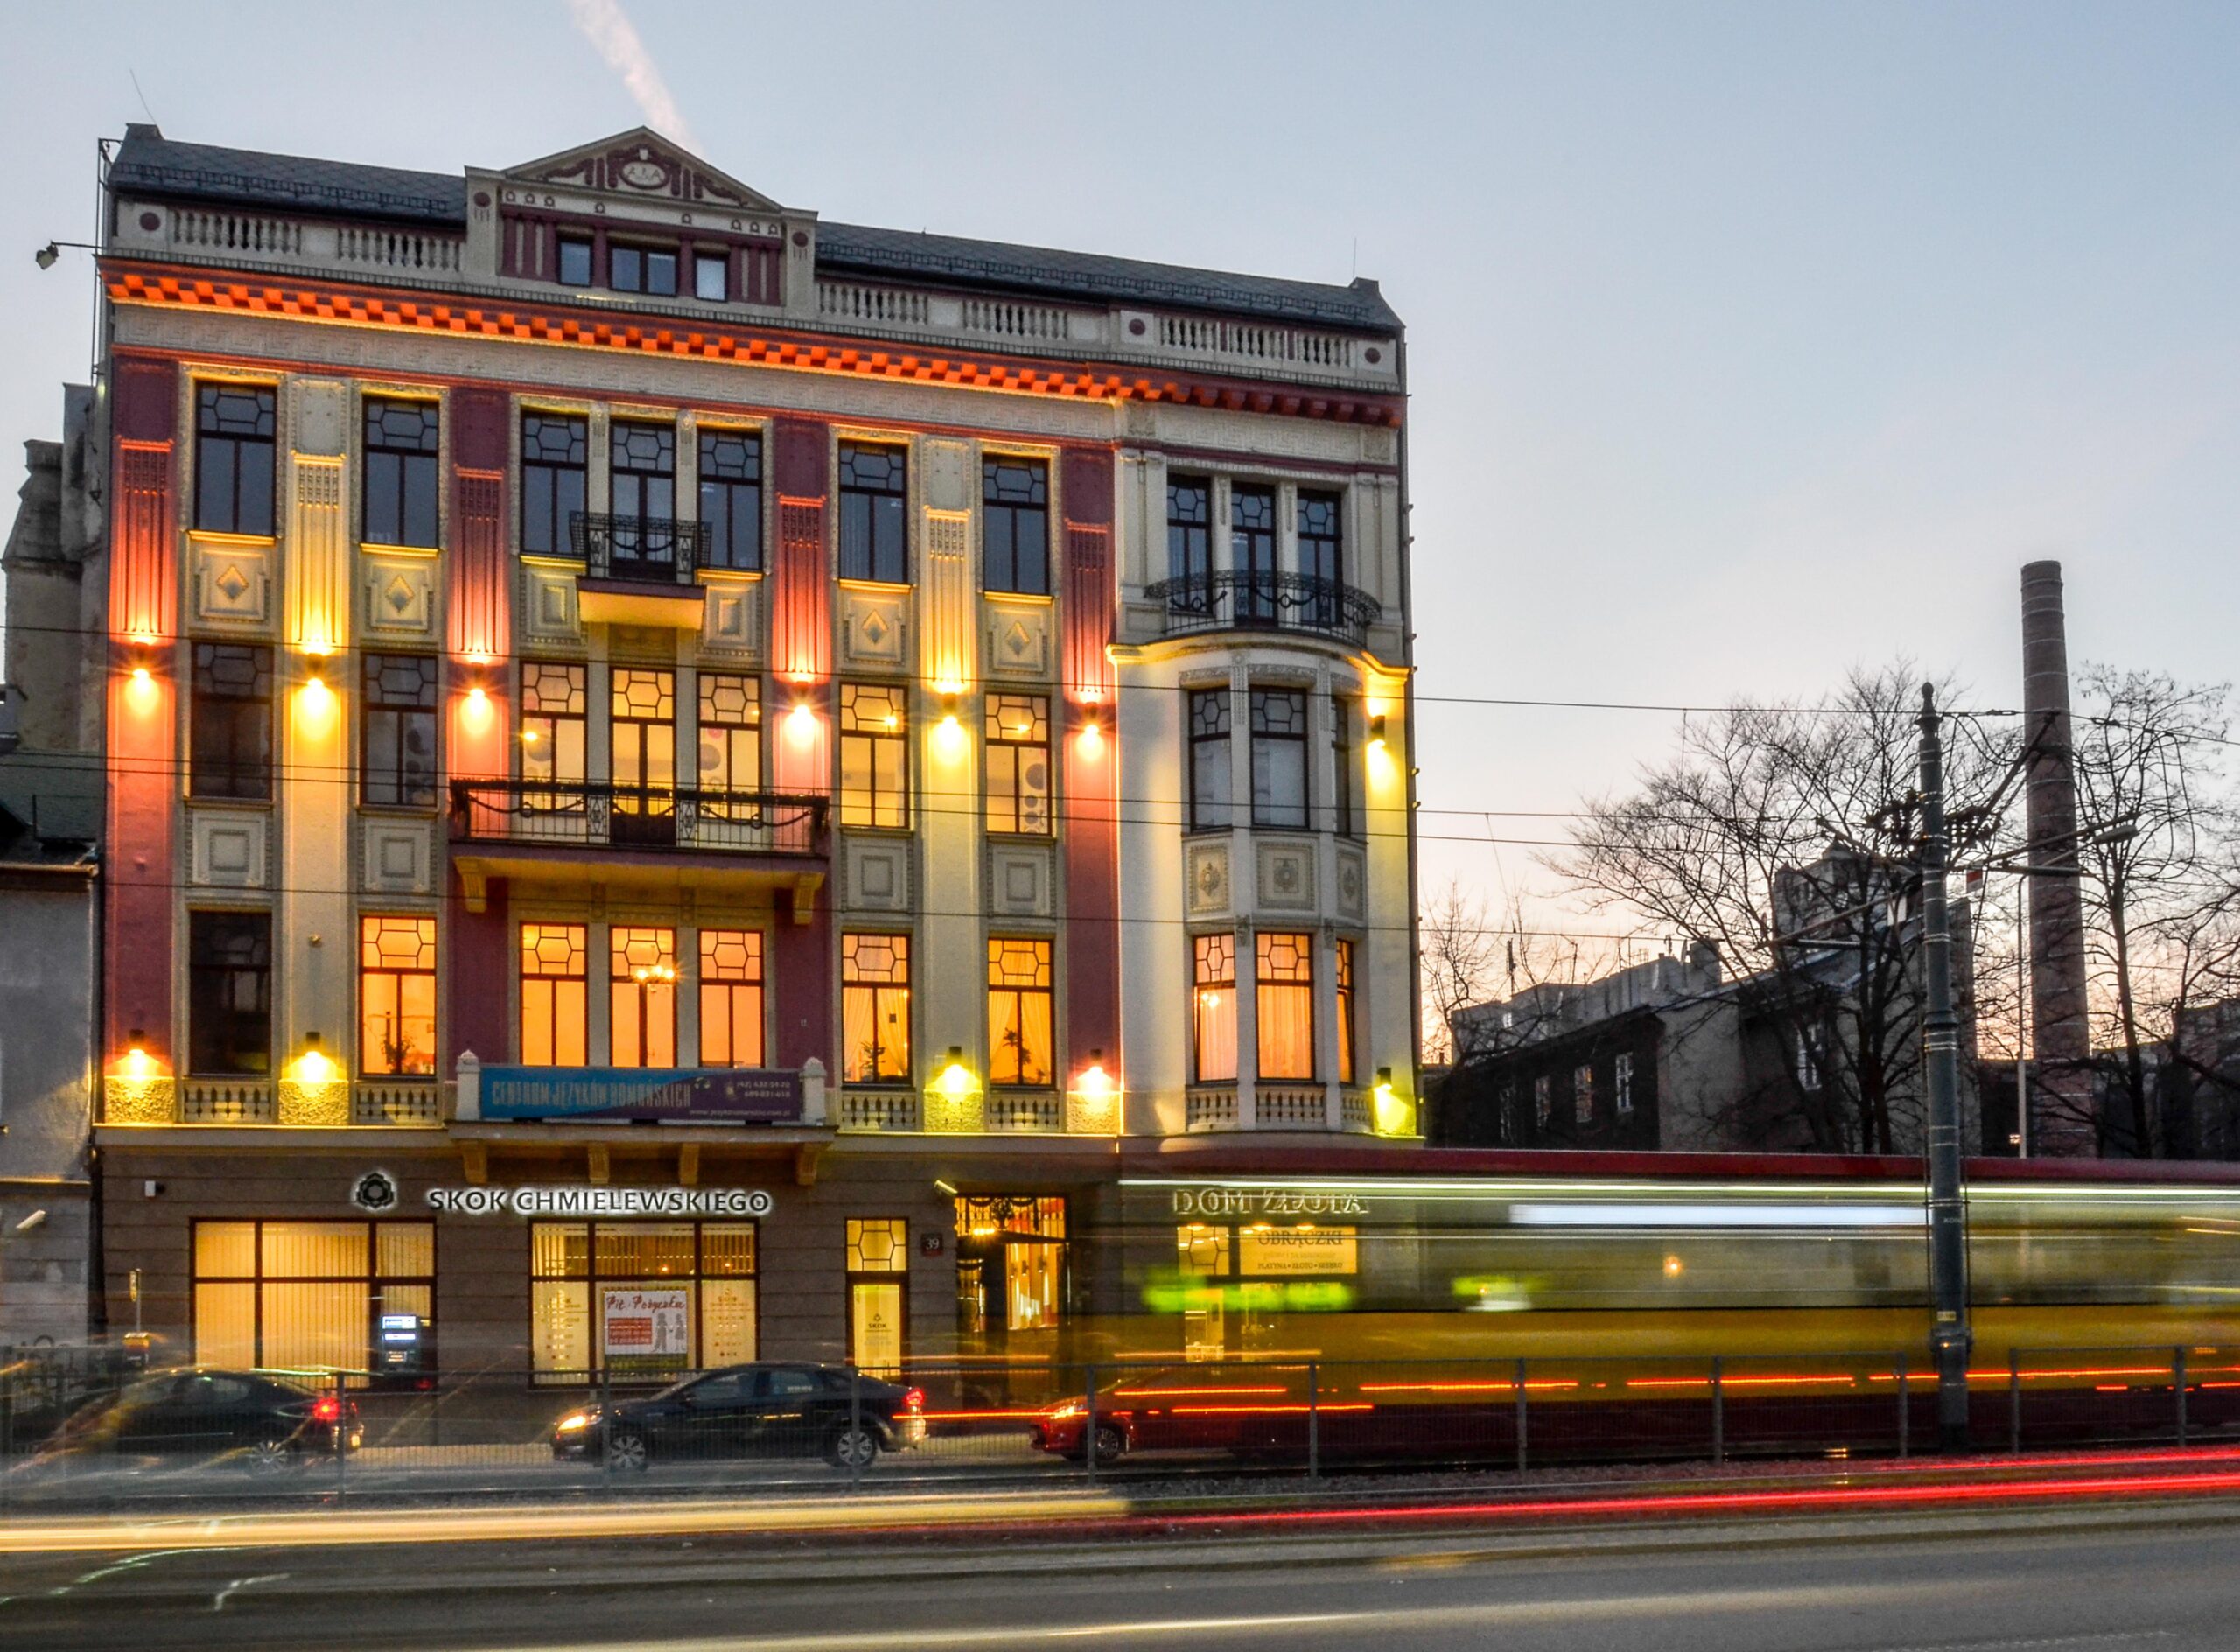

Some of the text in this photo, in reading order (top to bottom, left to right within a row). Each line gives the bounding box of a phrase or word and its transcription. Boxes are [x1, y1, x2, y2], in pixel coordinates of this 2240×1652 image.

[492, 1081, 550, 1106] CENTRUM
[429, 1190, 770, 1212] SKOK CHMIELEWSKIEGO
[1173, 1188, 1253, 1214] DOM
[926, 1238, 940, 1250] 39
[1257, 1229, 1343, 1248] OBRĄCZKI
